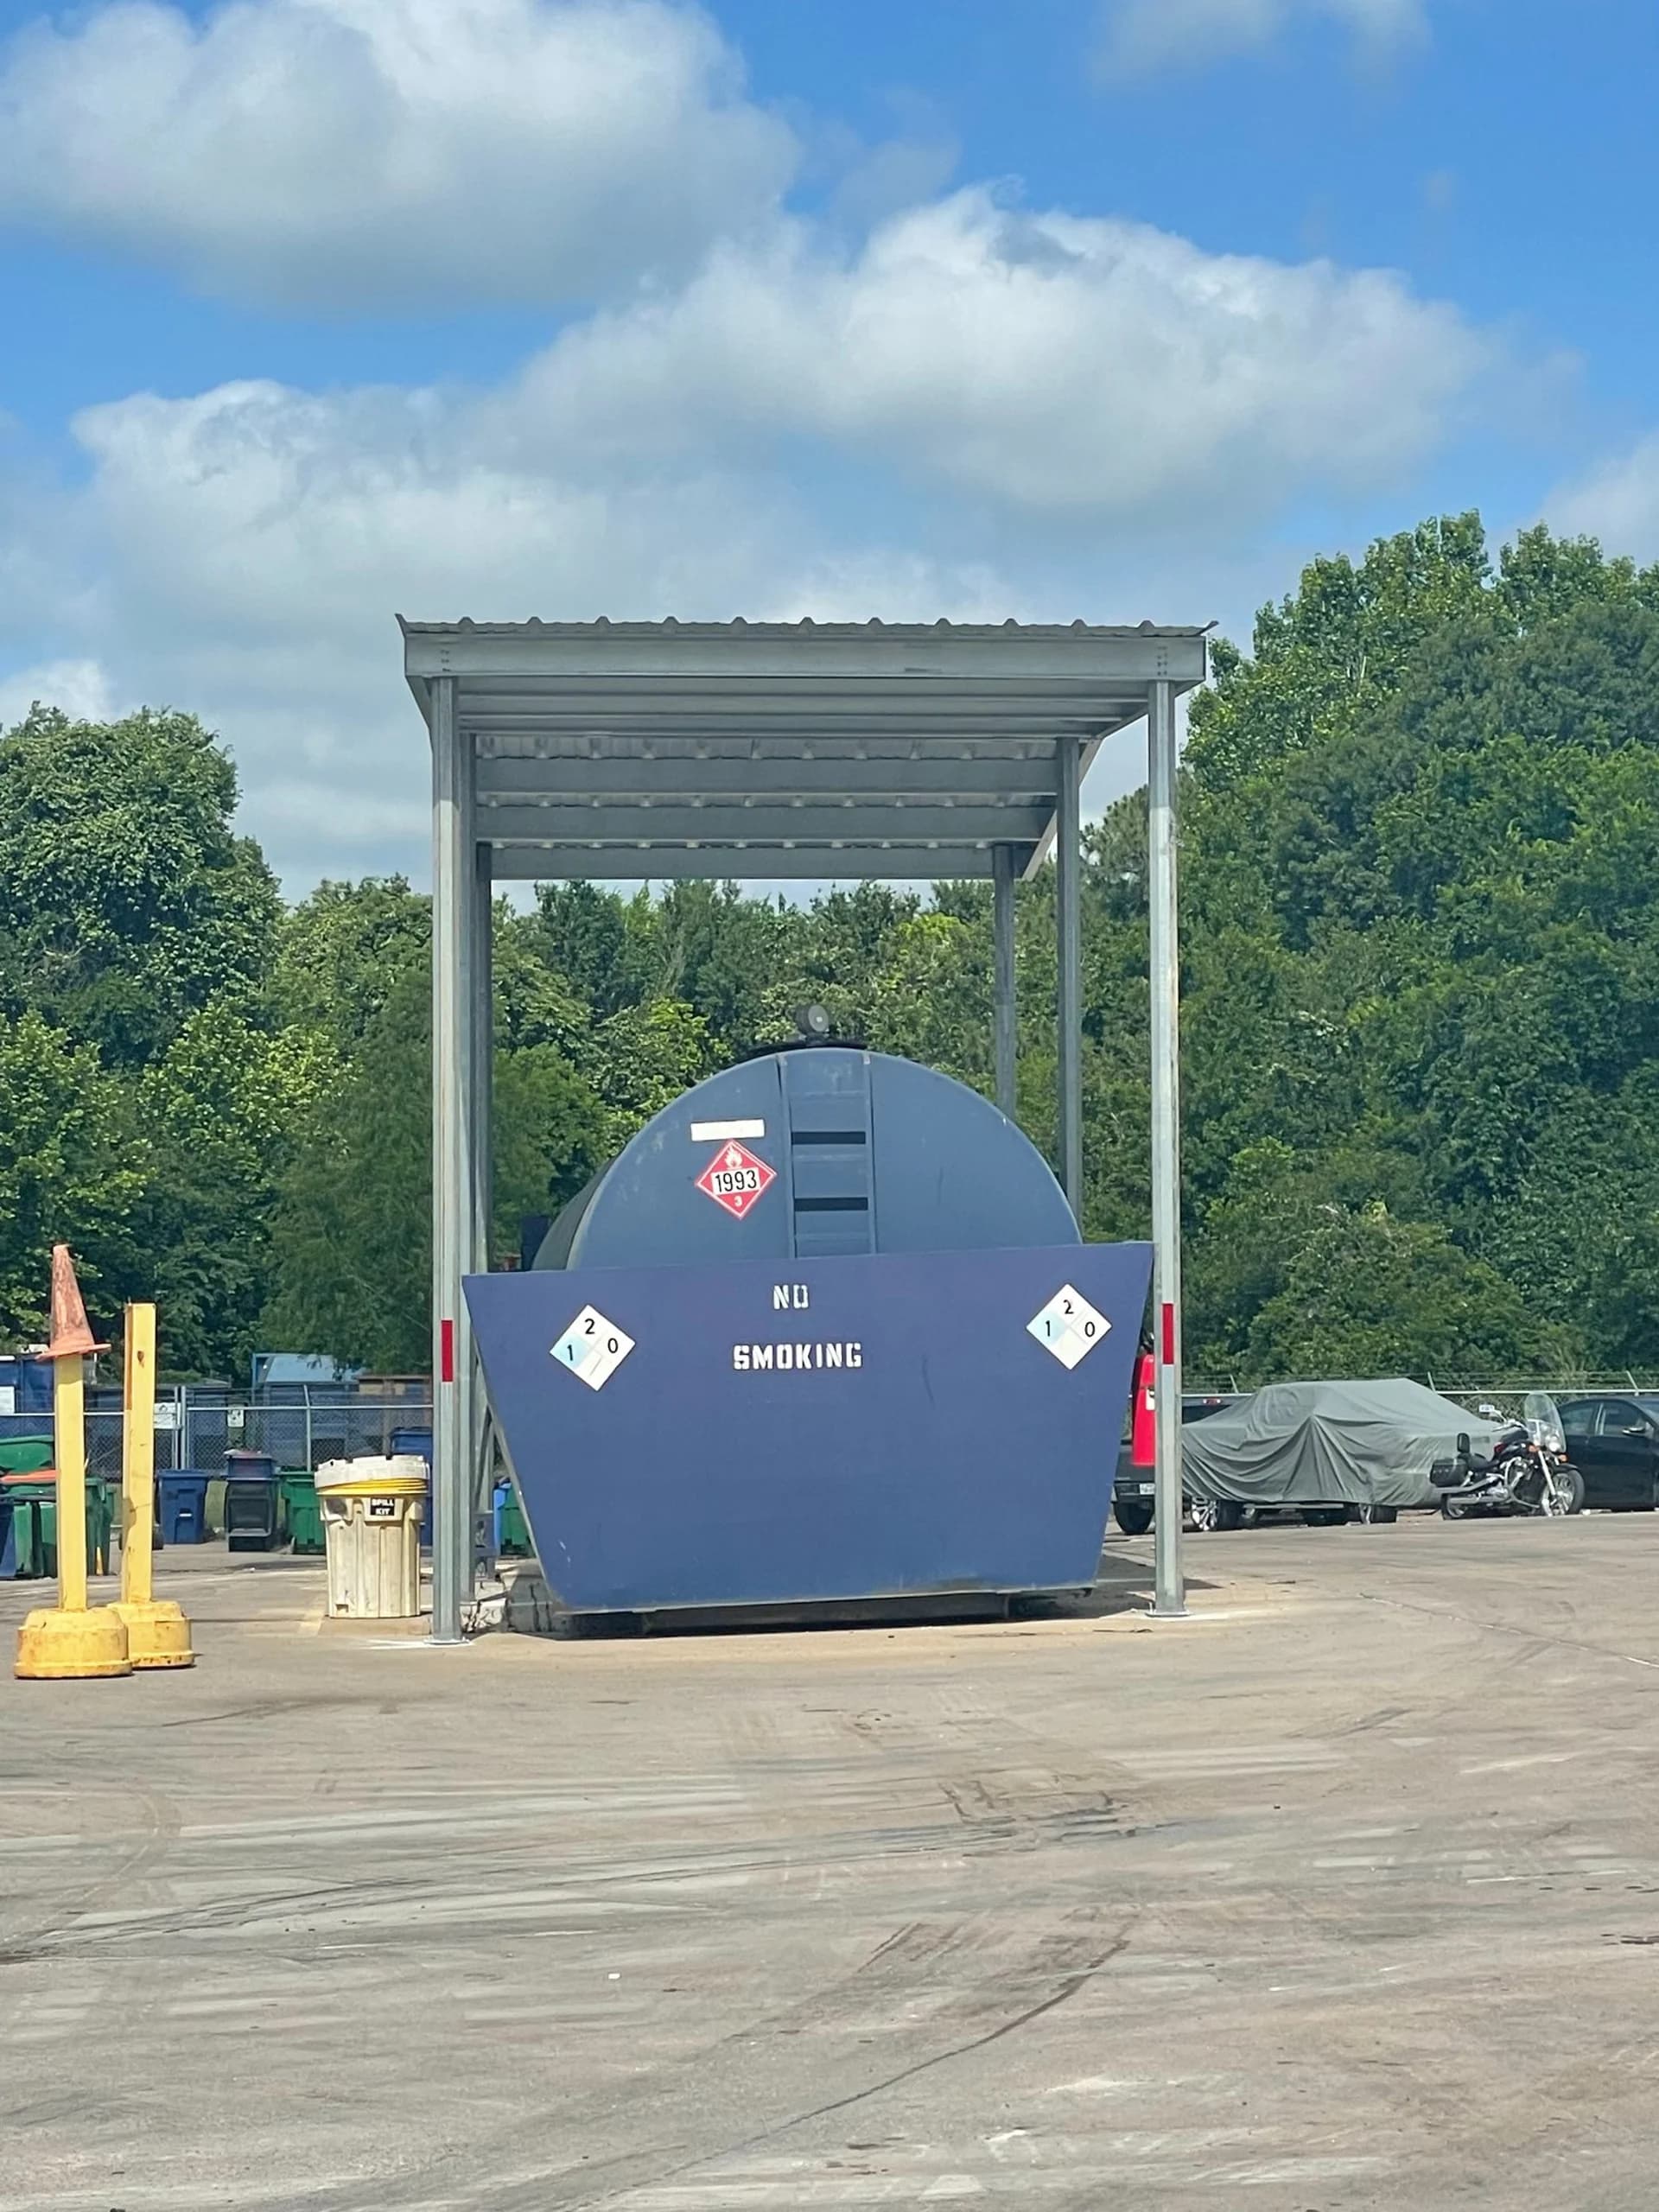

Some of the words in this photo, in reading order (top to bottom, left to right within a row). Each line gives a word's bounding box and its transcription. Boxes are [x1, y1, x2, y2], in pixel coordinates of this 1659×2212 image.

[715, 1170, 757, 1193] 1993
[734, 1195, 743, 1207] 3
[773, 1284, 809, 1310] NO
[1063, 1299, 1074, 1315] 2
[584, 1318, 595, 1335] 2
[1045, 1319, 1051, 1338] 1
[1084, 1321, 1096, 1338] 0
[567, 1344, 574, 1361] 1
[607, 1338, 619, 1354] 0
[733, 1342, 863, 1370] SMOKING
